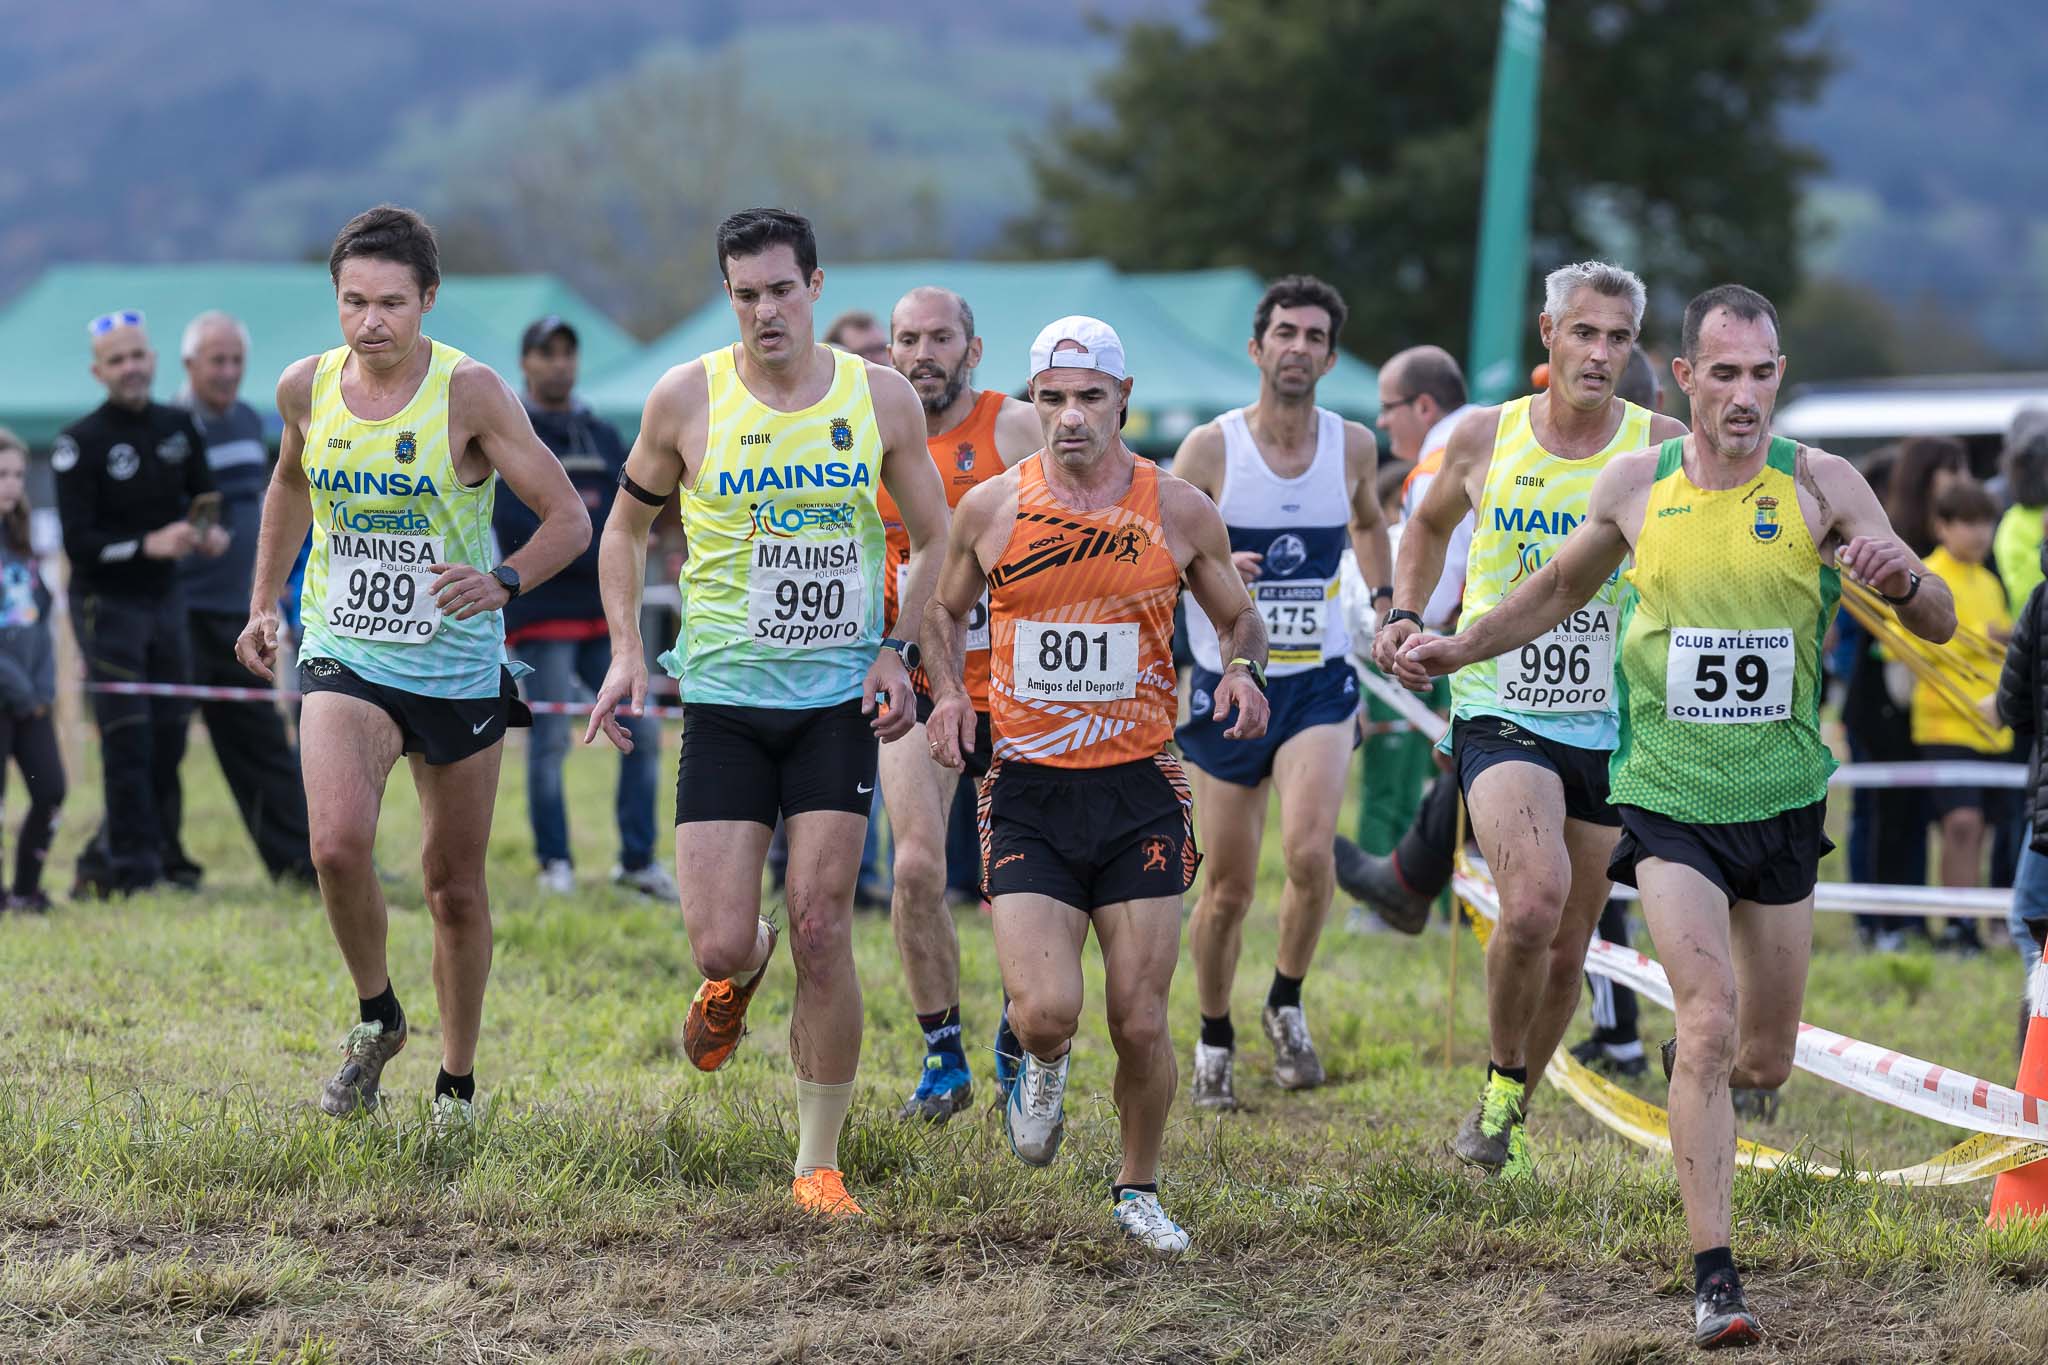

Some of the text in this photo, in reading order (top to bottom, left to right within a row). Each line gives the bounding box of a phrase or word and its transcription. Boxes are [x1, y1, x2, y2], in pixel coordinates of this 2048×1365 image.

[327, 438, 352, 450] GOBIK
[740, 433, 771, 446] GOBIK
[310, 467, 439, 497] MAINSA
[719, 462, 869, 496] MAINSA
[1515, 475, 1545, 487] GOBIK
[1494, 507, 1586, 536] MAIN
[331, 534, 437, 565] MAINSA
[757, 541, 859, 570] MAINSA
[380, 562, 431, 574] POLIGRUA
[347, 568, 416, 615] 989
[774, 578, 845, 622] 990
[329, 606, 433, 636] Sapporo
[754, 617, 859, 645] Sapporo
[1267, 606, 1317, 635] 175
[1553, 610, 1610, 634] NSA
[1038, 629, 1109, 672] 801
[1555, 633, 1610, 643] POLIGRUAS
[1675, 633, 1789, 649] CLUB ATLÉTICO
[1520, 643, 1591, 685] 996
[1693, 654, 1769, 702] 59
[1027, 677, 1125, 695] Amigos del Deporte
[1504, 681, 1606, 708] Sapporo
[1673, 704, 1787, 718] COLINDRES
